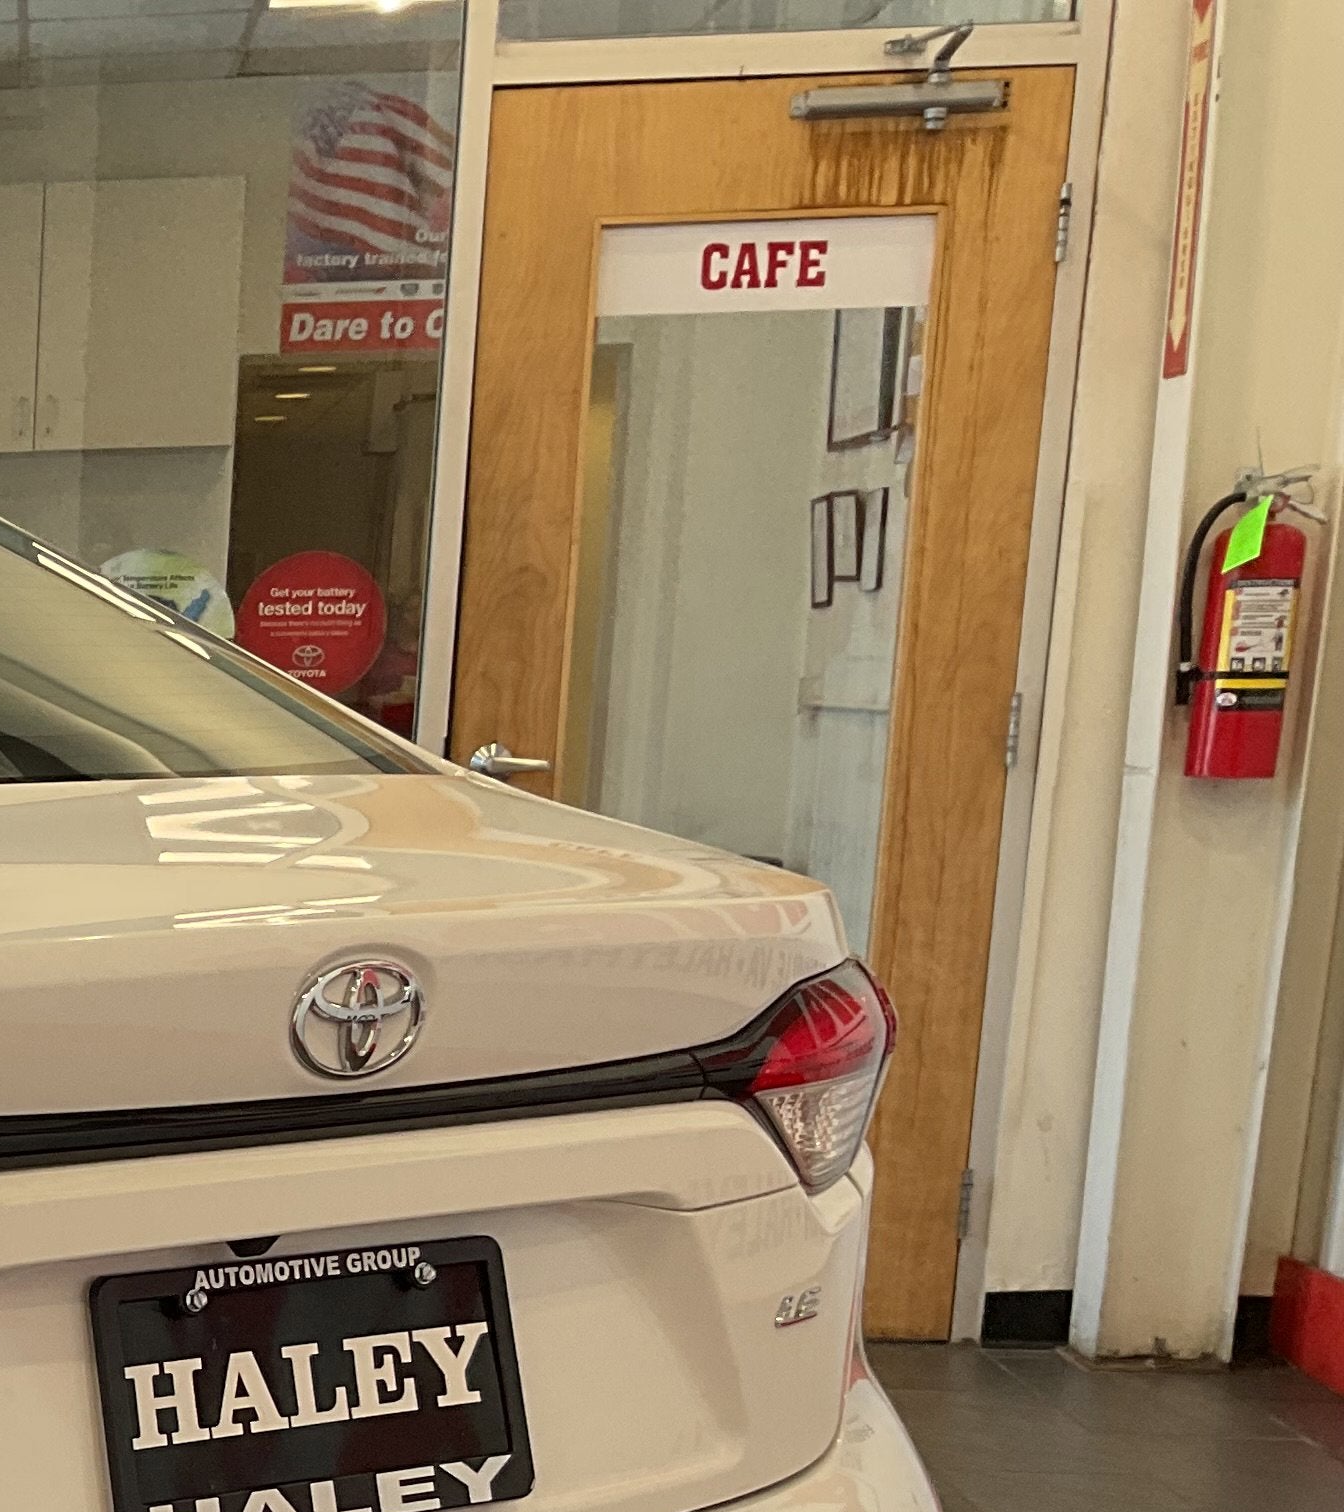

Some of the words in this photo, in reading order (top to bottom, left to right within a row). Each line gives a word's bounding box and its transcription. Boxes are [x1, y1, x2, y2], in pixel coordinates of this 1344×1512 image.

[296, 253, 359, 269] factory
[701, 240, 828, 290] CAFE
[289, 312, 368, 342] Dare
[380, 311, 414, 339] to
[258, 601, 313, 616] tested
[318, 600, 368, 617] today
[270, 587, 289, 598] Get
[291, 588, 316, 599] your
[317, 587, 356, 598] battery
[195, 1256, 341, 1290] AUTOMOTIVE
[346, 1247, 421, 1273] GROUP
[124, 1321, 488, 1451] HALEY
